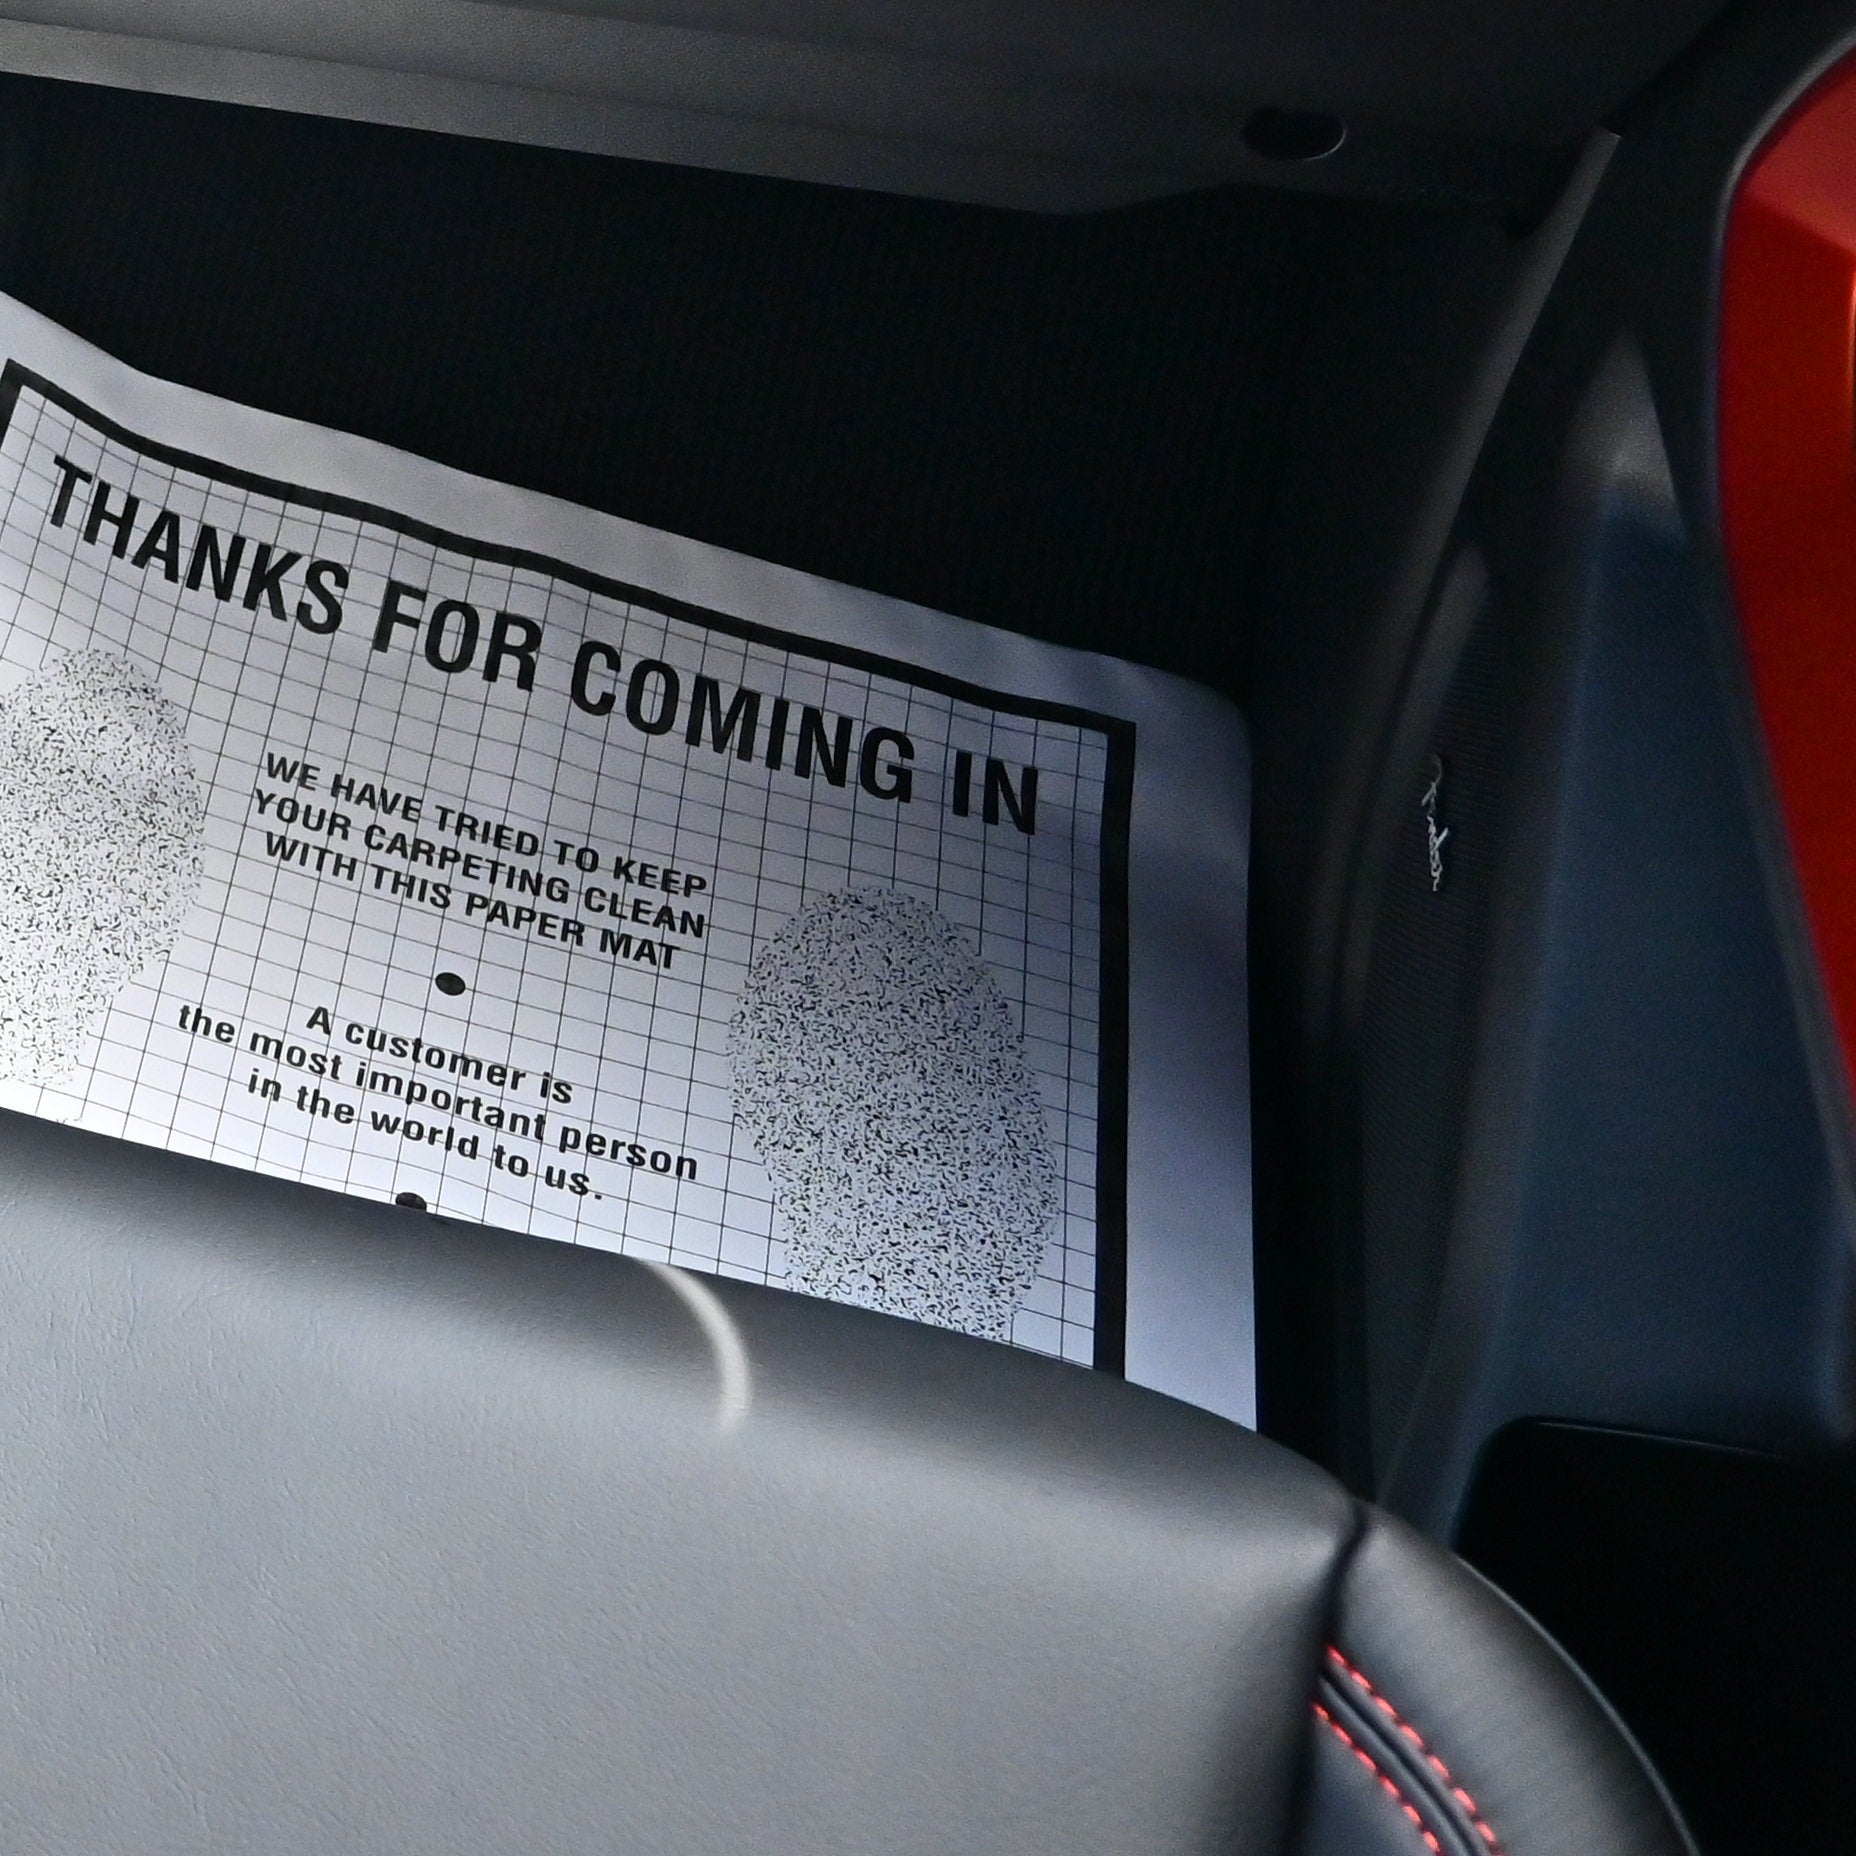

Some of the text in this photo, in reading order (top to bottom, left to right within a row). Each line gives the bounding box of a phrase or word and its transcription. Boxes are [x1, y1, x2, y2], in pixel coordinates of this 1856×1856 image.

[50, 454, 1038, 835] THANKS FOR COMING IN
[255, 790, 705, 938] YOUR CARPETING CLEAN
[267, 752, 707, 898] WE HAVE TRIED TO KEEP
[266, 832, 680, 969] WITH THIS PAPER MAT
[178, 1005, 698, 1180] the most important person
[307, 1007, 573, 1104] A customer is
[247, 1068, 602, 1199] in the world to us.
